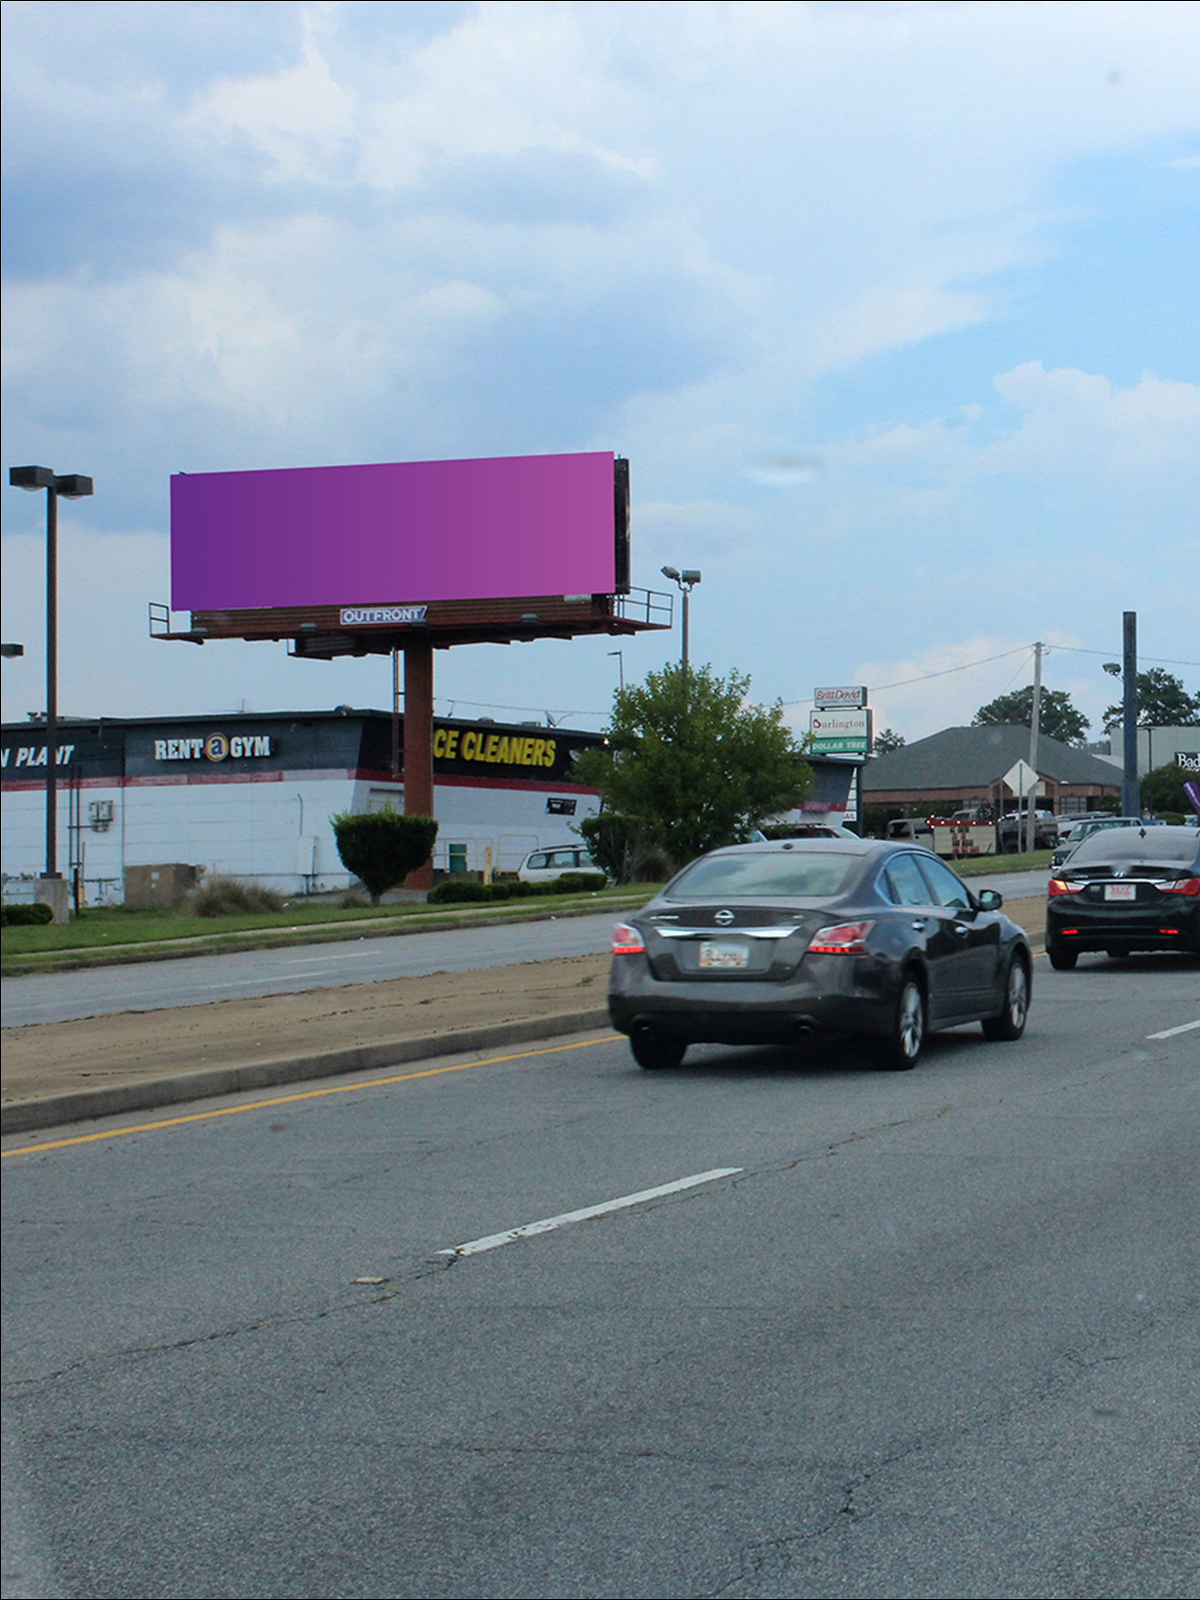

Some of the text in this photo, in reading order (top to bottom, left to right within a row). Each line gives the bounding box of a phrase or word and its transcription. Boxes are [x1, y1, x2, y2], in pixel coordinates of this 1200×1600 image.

[154, 738, 204, 760] RENT
[229, 735, 271, 758] GYM
[461, 731, 556, 768] CLEANERS
[812, 742, 844, 750] DOLLAR
